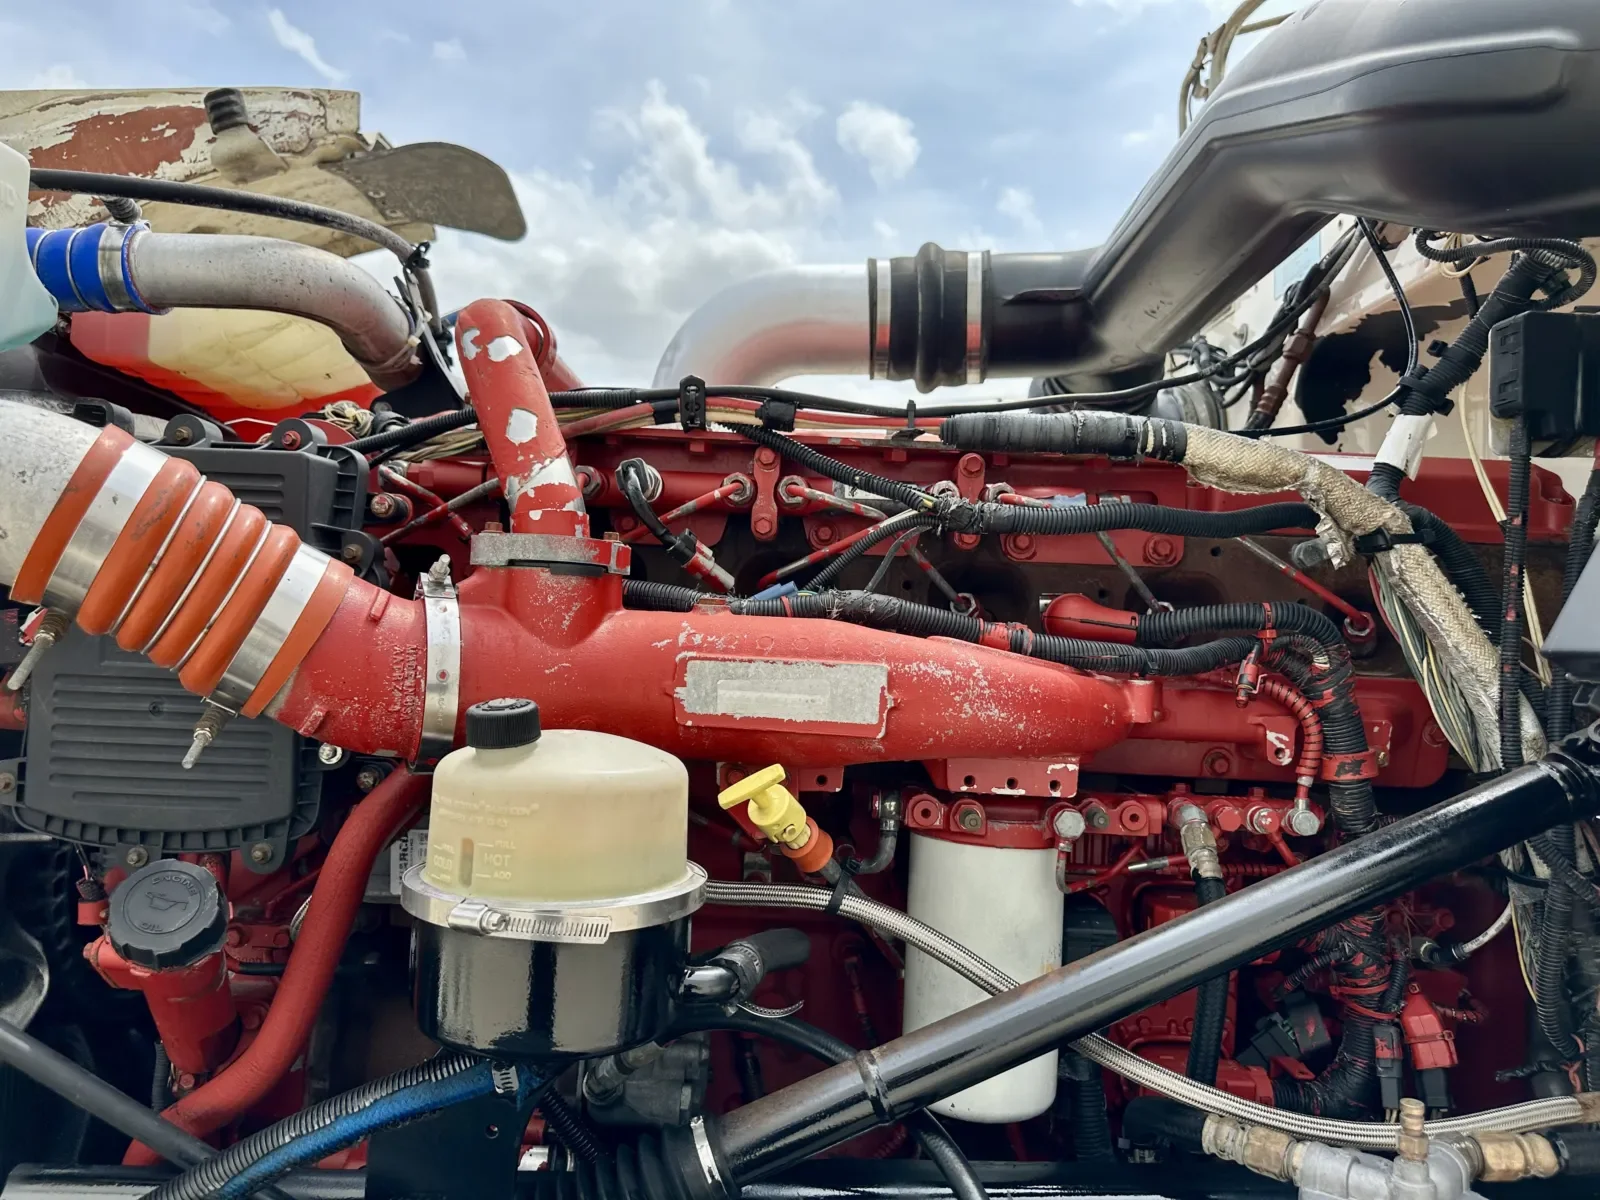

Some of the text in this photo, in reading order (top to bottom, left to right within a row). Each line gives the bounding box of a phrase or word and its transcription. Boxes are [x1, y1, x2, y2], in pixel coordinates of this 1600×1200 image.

[433, 855, 452, 871] COLD
[484, 853, 512, 867] HOT
[151, 875, 198, 897] ENGINE
[140, 922, 164, 932] OIL
